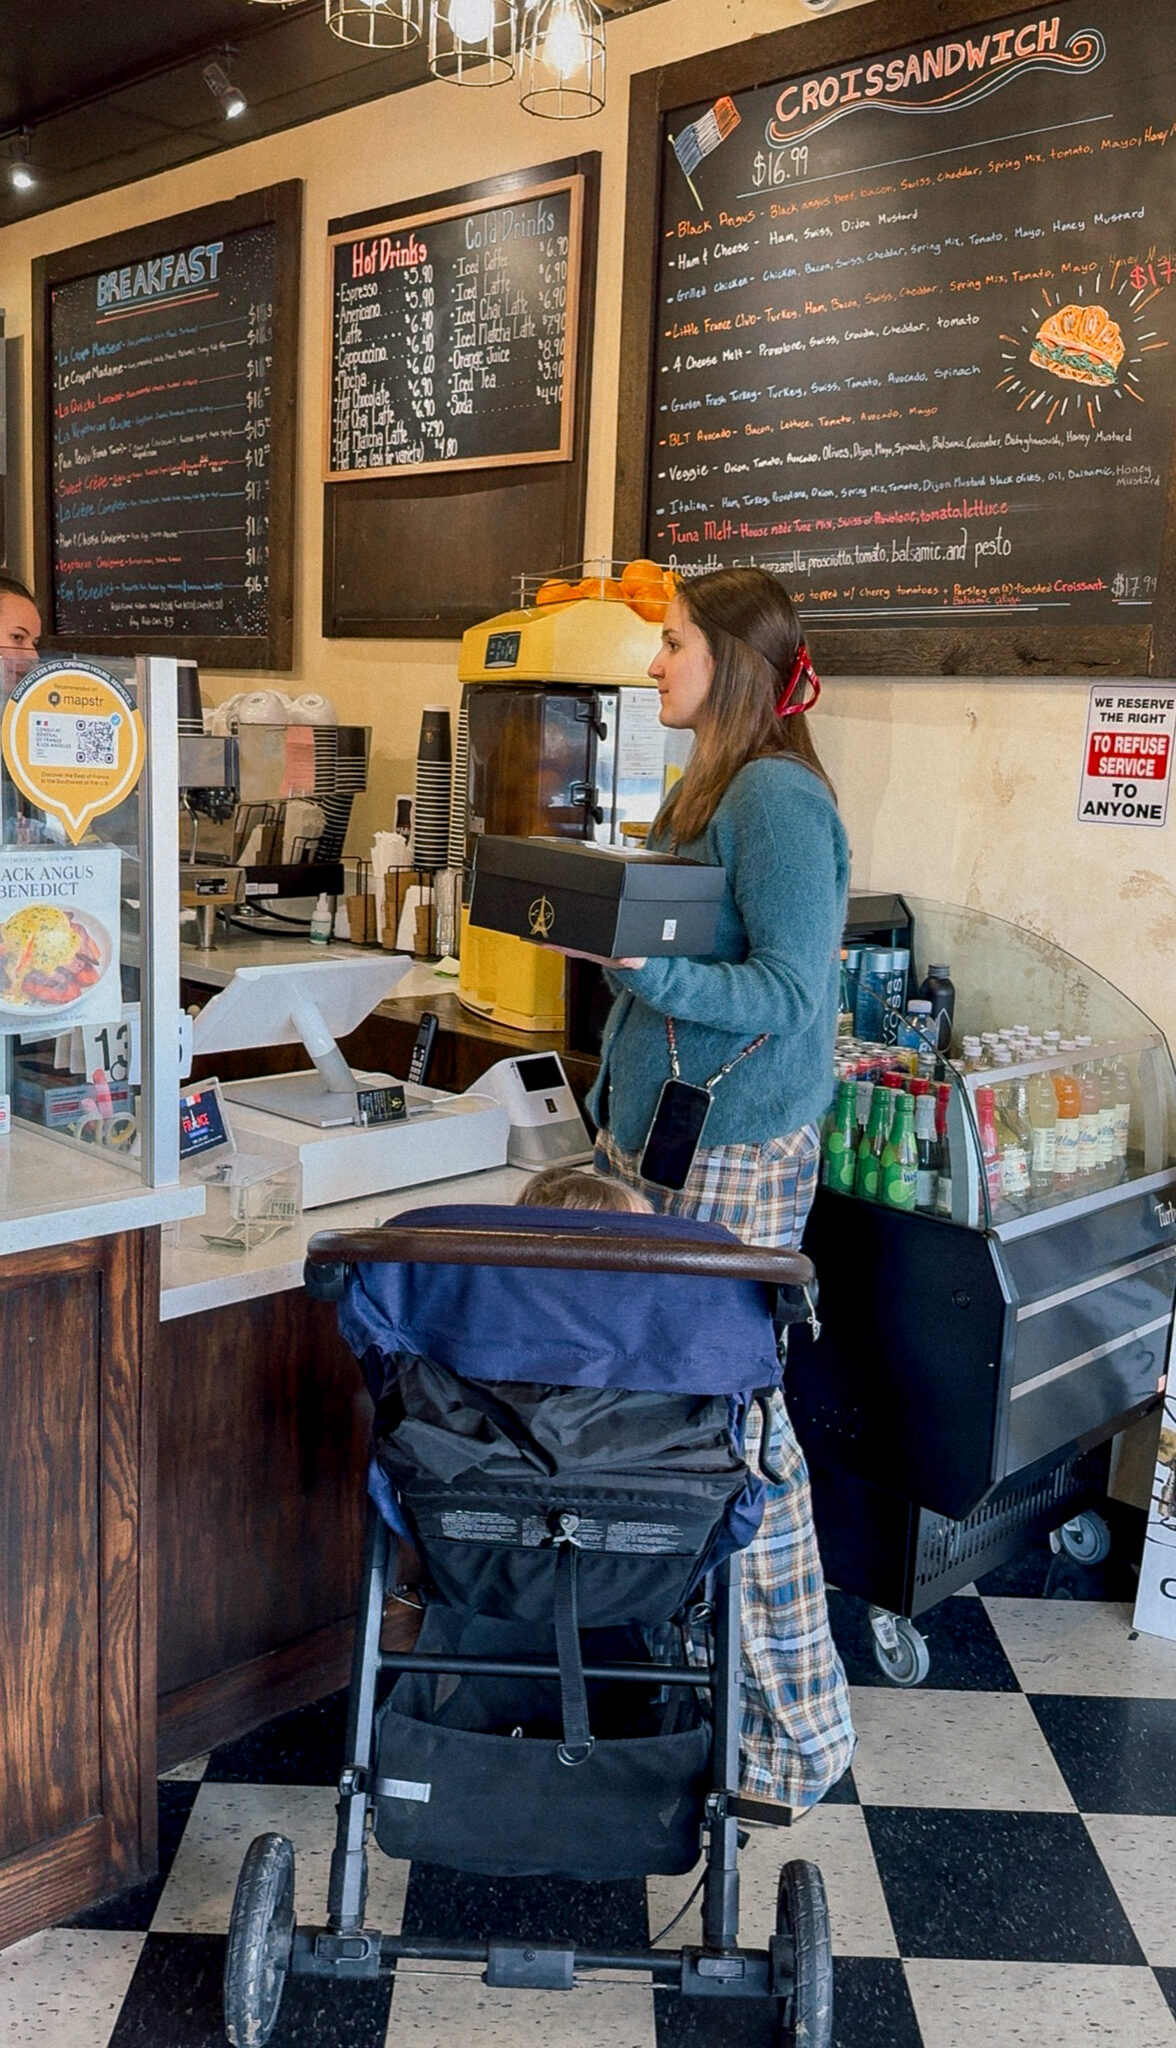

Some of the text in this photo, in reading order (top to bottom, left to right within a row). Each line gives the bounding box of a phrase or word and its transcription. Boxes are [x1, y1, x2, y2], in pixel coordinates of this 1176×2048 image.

[775, 17, 1061, 123] CROISSANDWICH
[752, 146, 809, 187] $16.99
[677, 221, 712, 238] Black
[719, 210, 756, 228] Angus
[770, 203, 799, 219] Black
[988, 160, 1021, 174] Spring
[465, 200, 555, 250] Cold Drinks
[678, 254, 700, 271] Ham
[714, 242, 750, 259] Cheese
[769, 232, 799, 245] Ham,
[878, 209, 919, 225] Mustard
[352, 233, 428, 278] Hot Drinks
[676, 285, 707, 302] Grilled
[910, 243, 942, 256] Spring
[1052, 220, 1086, 233] Honey
[1094, 206, 1145, 225] Mustard
[96, 241, 224, 307] BREAKFAST
[341, 264, 434, 306] Espresso $5.90
[484, 271, 511, 296] Latte
[340, 287, 435, 325] Americano $5.90
[505, 290, 528, 316] Latte
[672, 323, 700, 339] Little
[703, 317, 732, 334] France
[949, 279, 982, 292] Spring
[513, 317, 536, 339] Latte
[686, 354, 718, 369] Cheese
[937, 314, 980, 328] tomato
[453, 349, 484, 371] Orange
[486, 345, 510, 364] Juice
[934, 364, 981, 378] Spinach
[480, 367, 496, 389] Tea
[450, 392, 473, 416] Soda
[668, 431, 689, 447] BLT
[908, 406, 939, 417] Mayo
[669, 464, 709, 482] Veggie
[1066, 430, 1090, 447] Honey
[1095, 428, 1132, 442] Mustard
[840, 486, 867, 497] Spring
[989, 473, 1014, 486] black
[1116, 464, 1152, 478] Honey
[1116, 475, 1160, 487] Mustard
[667, 523, 699, 545] Tuna
[962, 499, 1008, 517] lettuce
[975, 526, 1012, 568] pesto
[809, 589, 838, 601] topped
[859, 585, 891, 600] cherry
[896, 582, 939, 596] tomatoes
[953, 583, 987, 599] Parsley
[1111, 573, 1158, 598] $17.99
[63, 694, 104, 708] mapstr
[1095, 698, 1175, 709] WE RESERVE
[1100, 712, 1166, 724] THE RIGHT
[1093, 735, 1167, 755] TO REFUSE
[1098, 757, 1156, 776] SERVICE
[1112, 783, 1137, 798] TO
[1083, 801, 1162, 819] ANYONE
[40, 865, 94, 881] ANGUS
[889, 977, 903, 1045] VOSS
